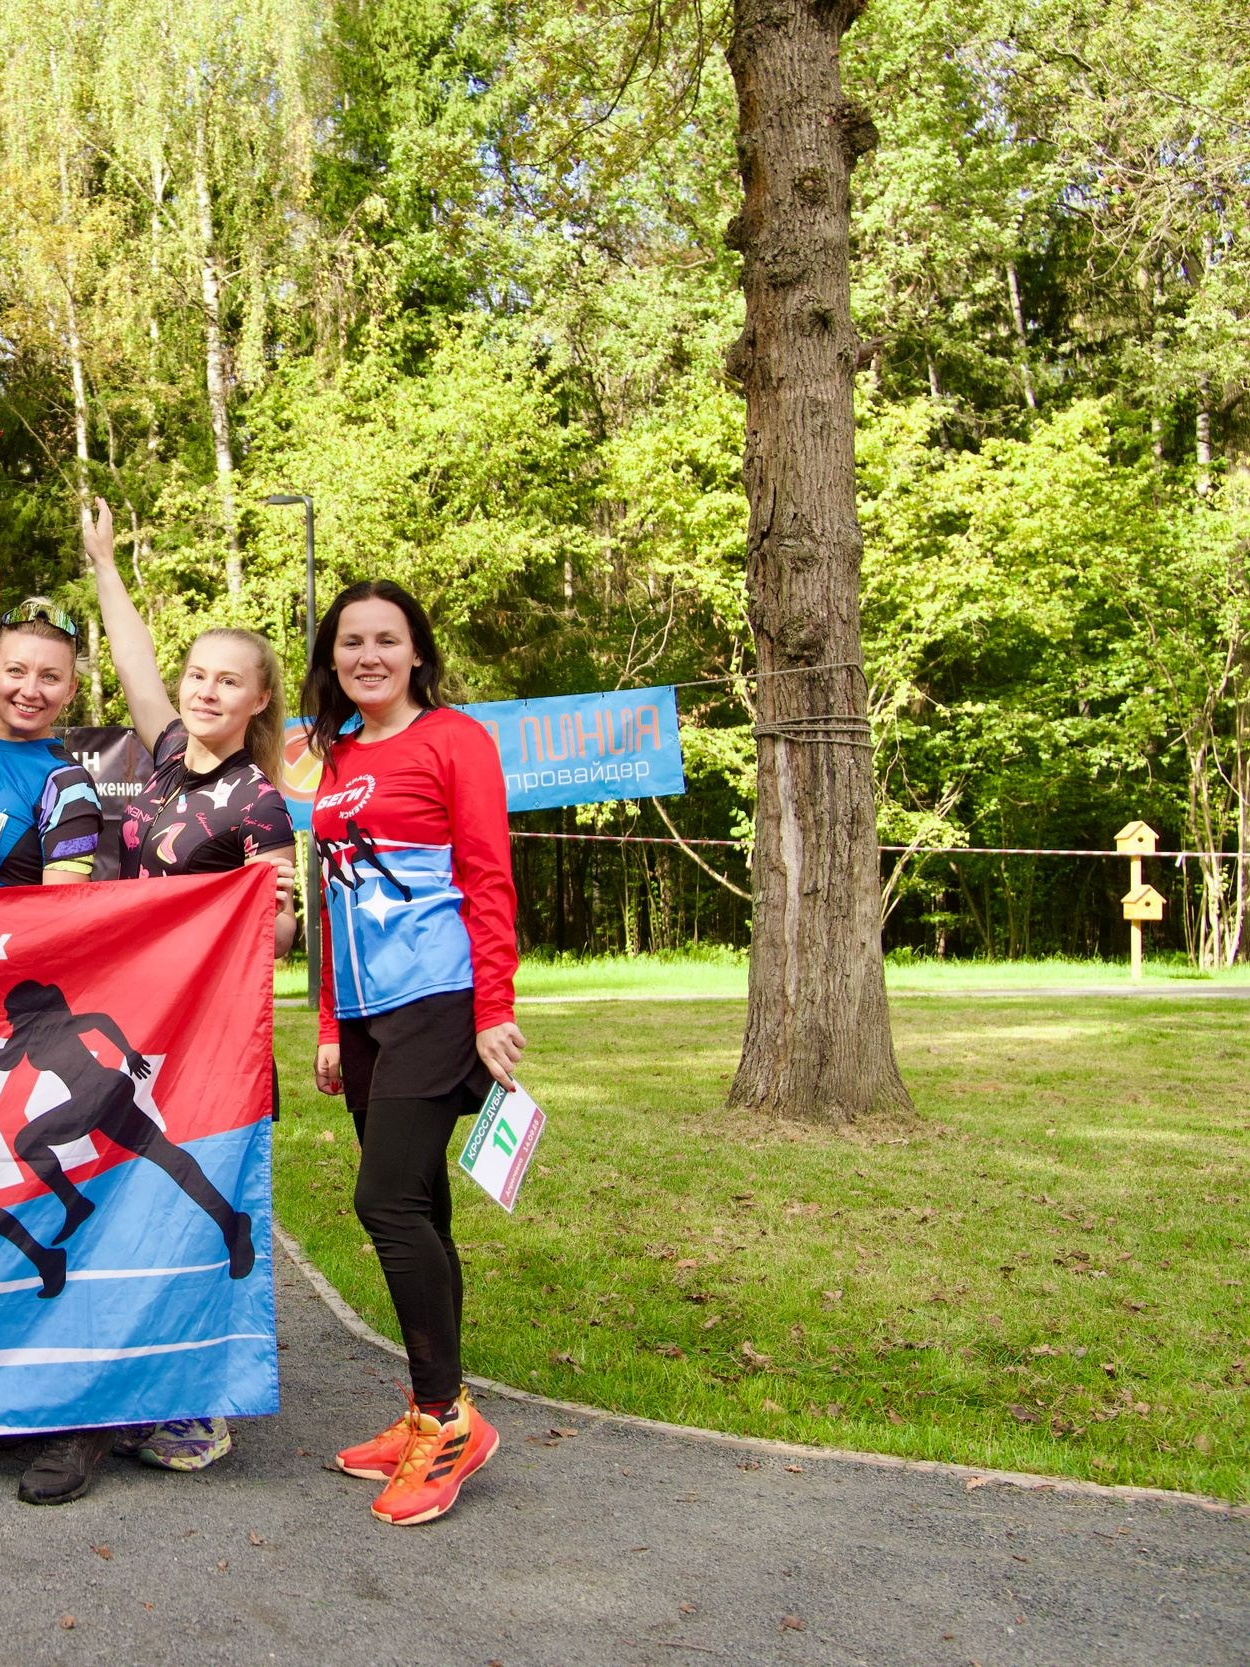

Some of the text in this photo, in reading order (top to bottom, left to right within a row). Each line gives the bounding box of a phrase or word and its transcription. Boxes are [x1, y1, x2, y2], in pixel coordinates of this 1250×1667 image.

[519, 705, 661, 763] ЛИНИЯ
[95, 782, 143, 797] жения
[506, 761, 650, 793] провайдер
[316, 786, 367, 811] БЕГИ
[468, 1119, 490, 1161] КРОСС
[492, 1117, 518, 1157] 17
